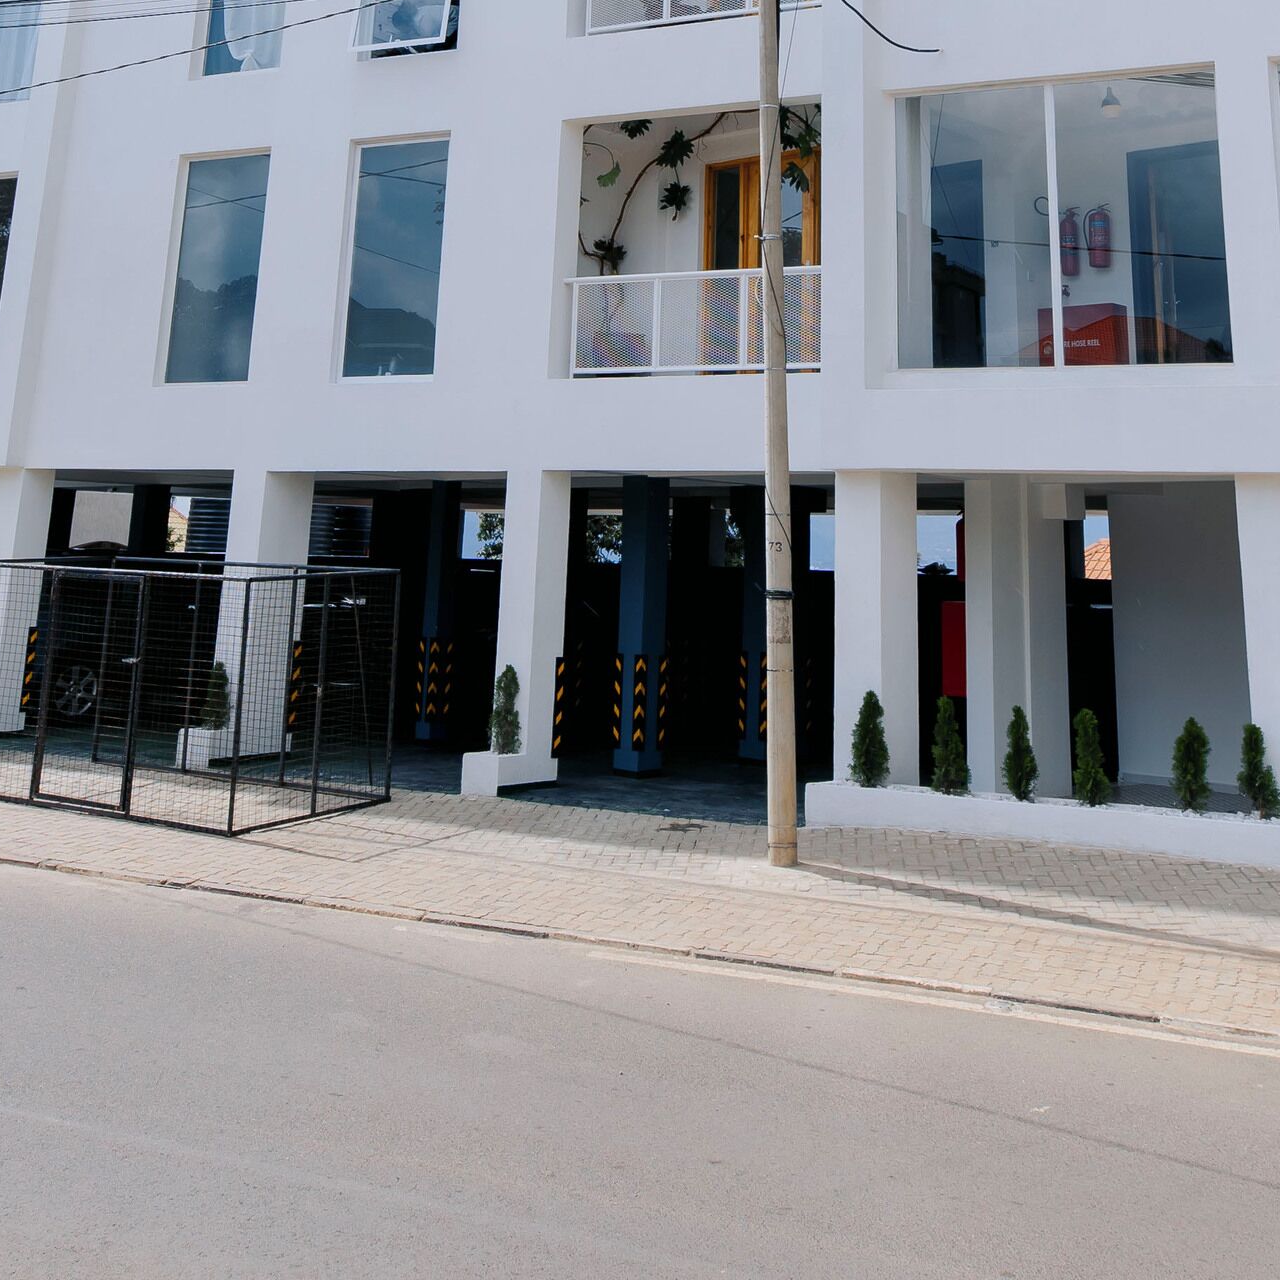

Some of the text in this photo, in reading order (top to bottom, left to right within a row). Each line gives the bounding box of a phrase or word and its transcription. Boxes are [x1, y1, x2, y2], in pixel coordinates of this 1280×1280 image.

[1071, 339, 1086, 347] HOSE
[1087, 338, 1100, 346] REEL
[767, 541, 783, 553] 73
